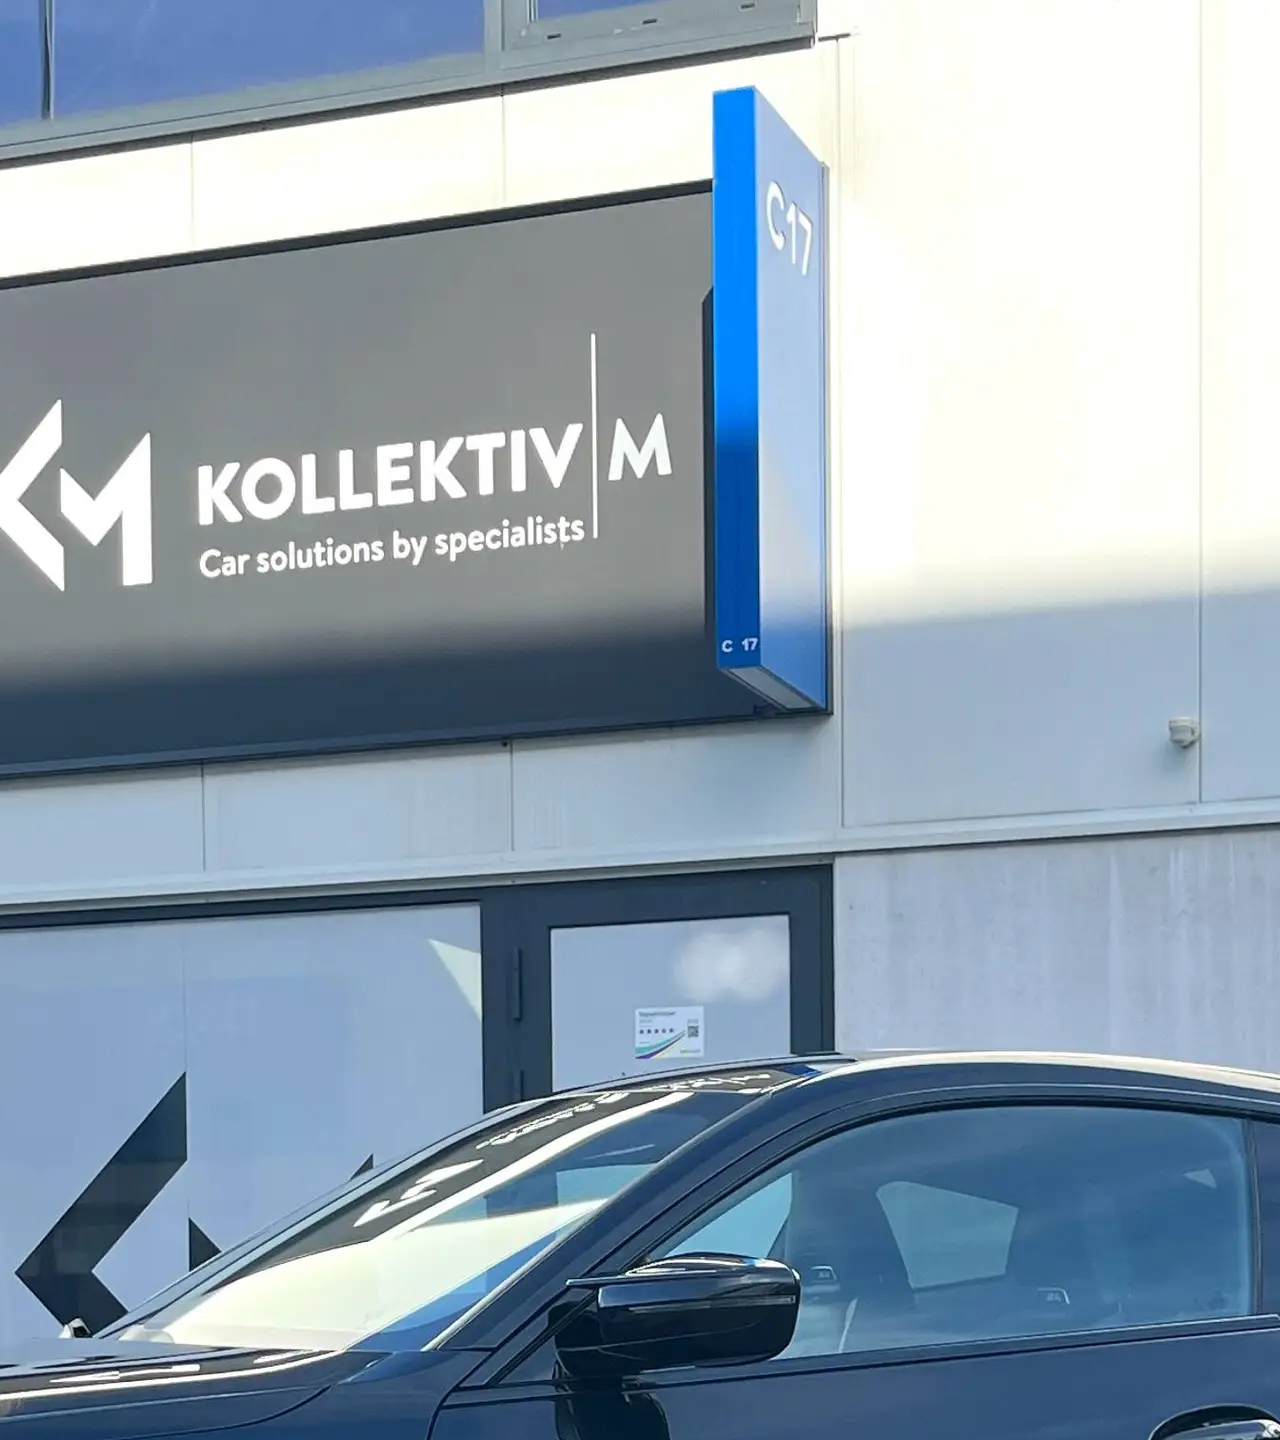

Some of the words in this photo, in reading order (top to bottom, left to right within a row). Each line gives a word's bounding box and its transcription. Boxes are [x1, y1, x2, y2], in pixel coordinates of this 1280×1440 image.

[766, 180, 813, 276] C17
[197, 423, 584, 526] KOLLEKTIV
[607, 413, 672, 481] M
[199, 548, 248, 578] Car
[256, 536, 385, 573] solutions
[392, 530, 428, 566] by
[434, 515, 585, 562] specialists
[722, 639, 734, 653] C
[741, 637, 759, 651] 17
